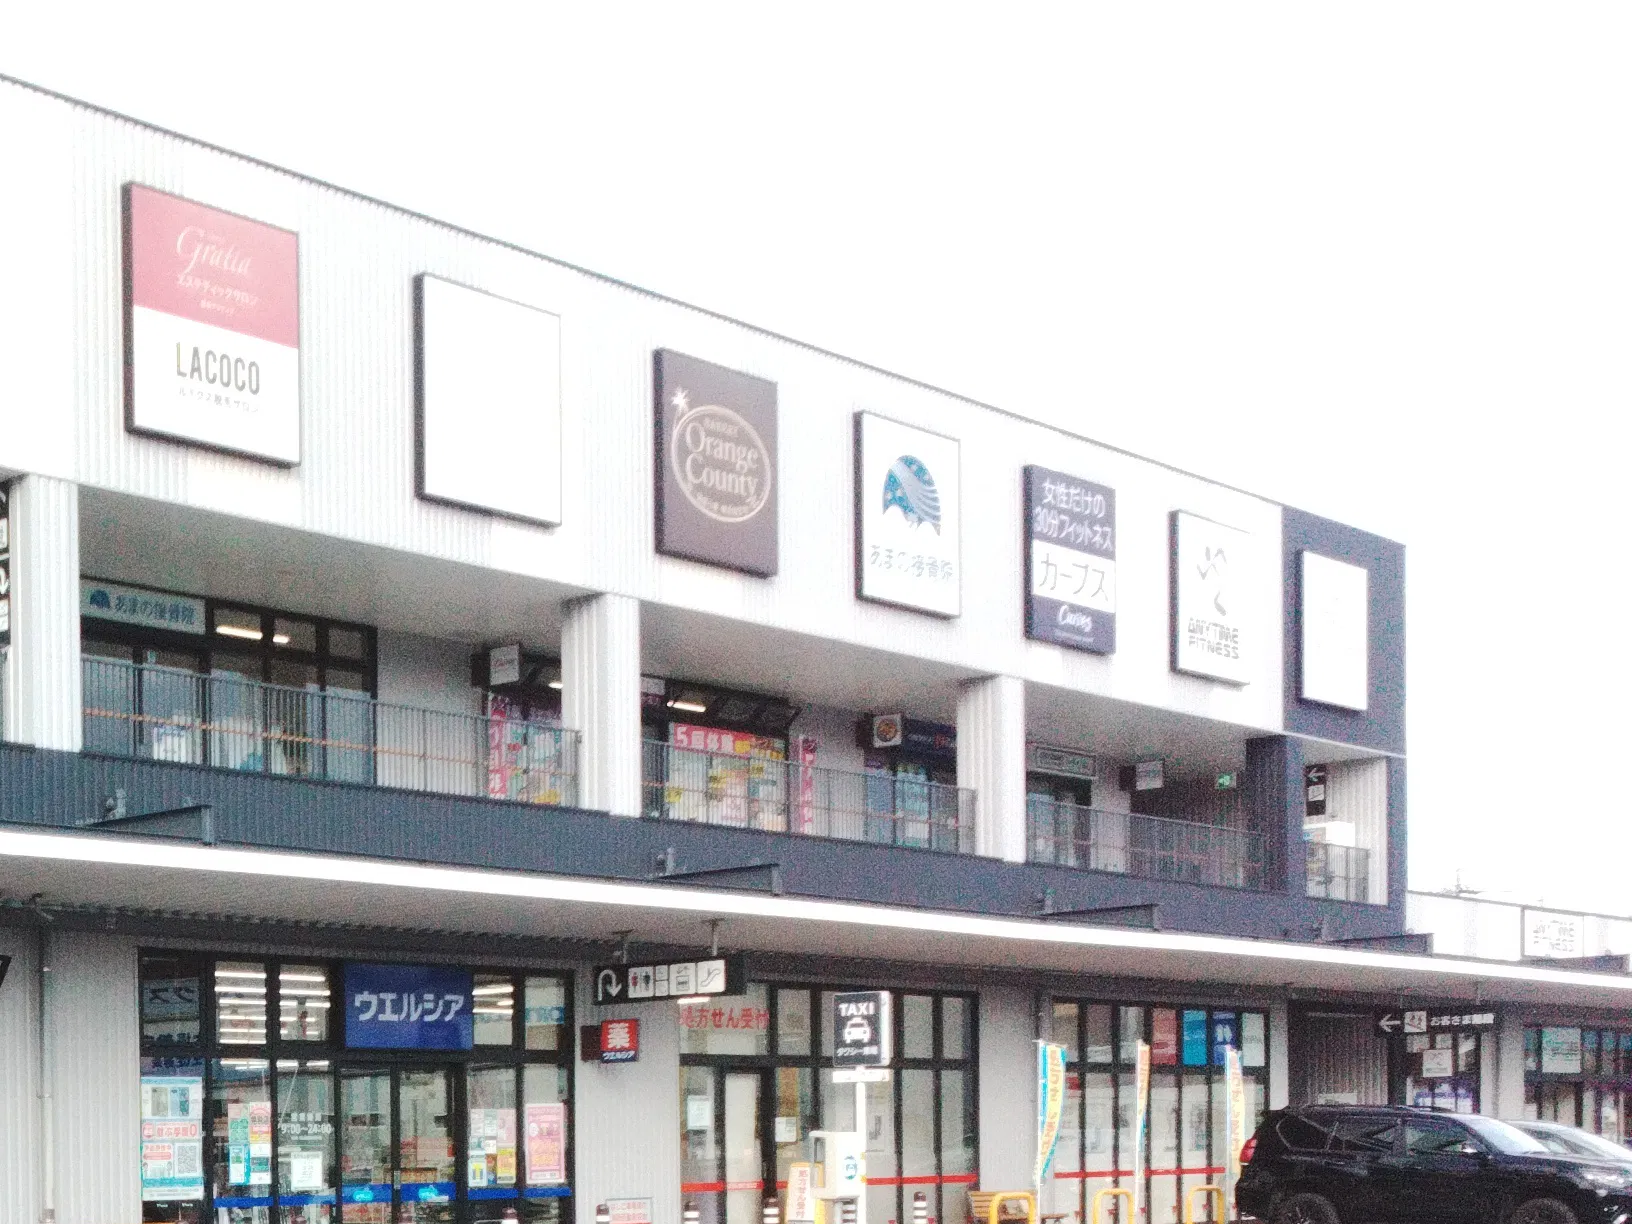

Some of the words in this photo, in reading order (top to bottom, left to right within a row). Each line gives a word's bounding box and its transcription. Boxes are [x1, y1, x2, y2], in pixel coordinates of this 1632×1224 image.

[176, 341, 261, 396] LACOCO
[686, 422, 759, 473] Orange
[685, 453, 759, 497] County
[1041, 477, 1106, 518] 女性だけの
[1034, 506, 1113, 551] 30分フィットネス
[1187, 616, 1240, 645] ANYTIME
[1188, 634, 1240, 660] FITNESS
[354, 991, 464, 1022] ウエルシア
[838, 1002, 875, 1016] TAXI
[607, 1022, 630, 1049] 薬
